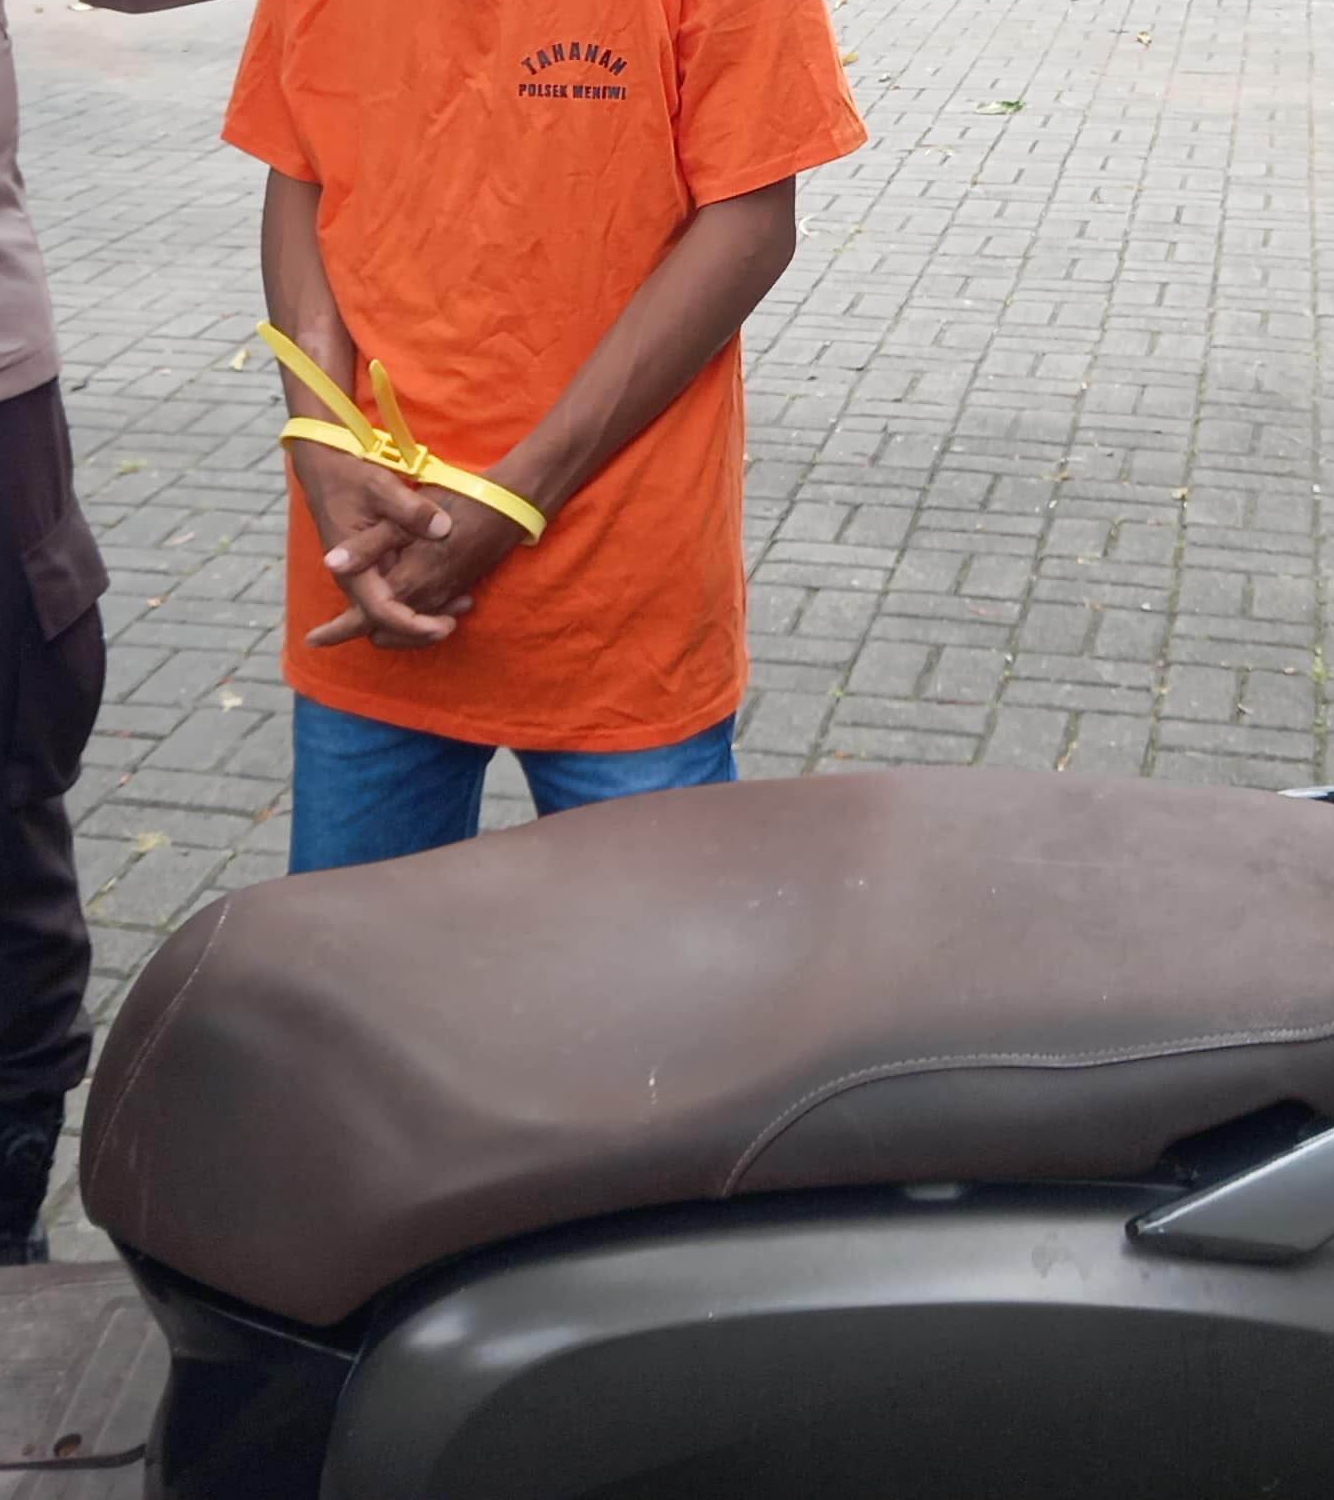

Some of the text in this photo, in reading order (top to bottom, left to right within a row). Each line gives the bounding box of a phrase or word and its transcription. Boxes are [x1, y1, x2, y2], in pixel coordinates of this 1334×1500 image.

[521, 41, 628, 77] TAHANAN
[518, 83, 627, 101] POLSEK MENGWI
